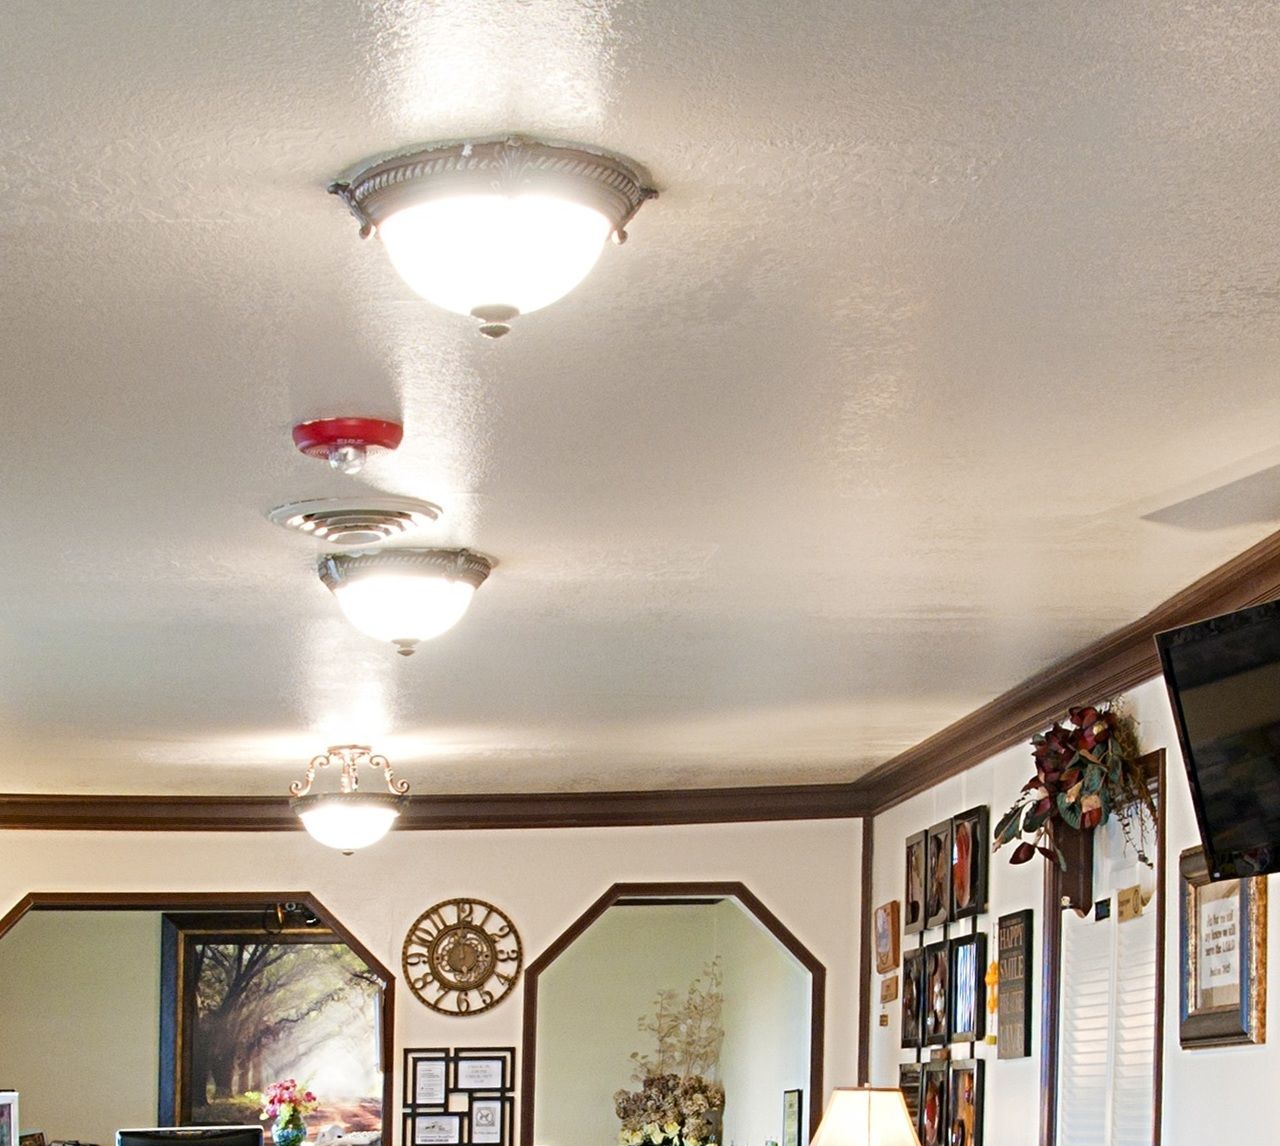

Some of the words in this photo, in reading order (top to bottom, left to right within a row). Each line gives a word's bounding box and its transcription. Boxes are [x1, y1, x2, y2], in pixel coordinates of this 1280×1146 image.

[456, 902, 474, 924] 12
[490, 924, 512, 943] 2
[1000, 923, 1024, 949] HAPPY
[496, 948, 519, 962] 3
[1000, 956, 1024, 980] SMILE
[412, 972, 435, 990] 8
[456, 990, 471, 1013] 6
